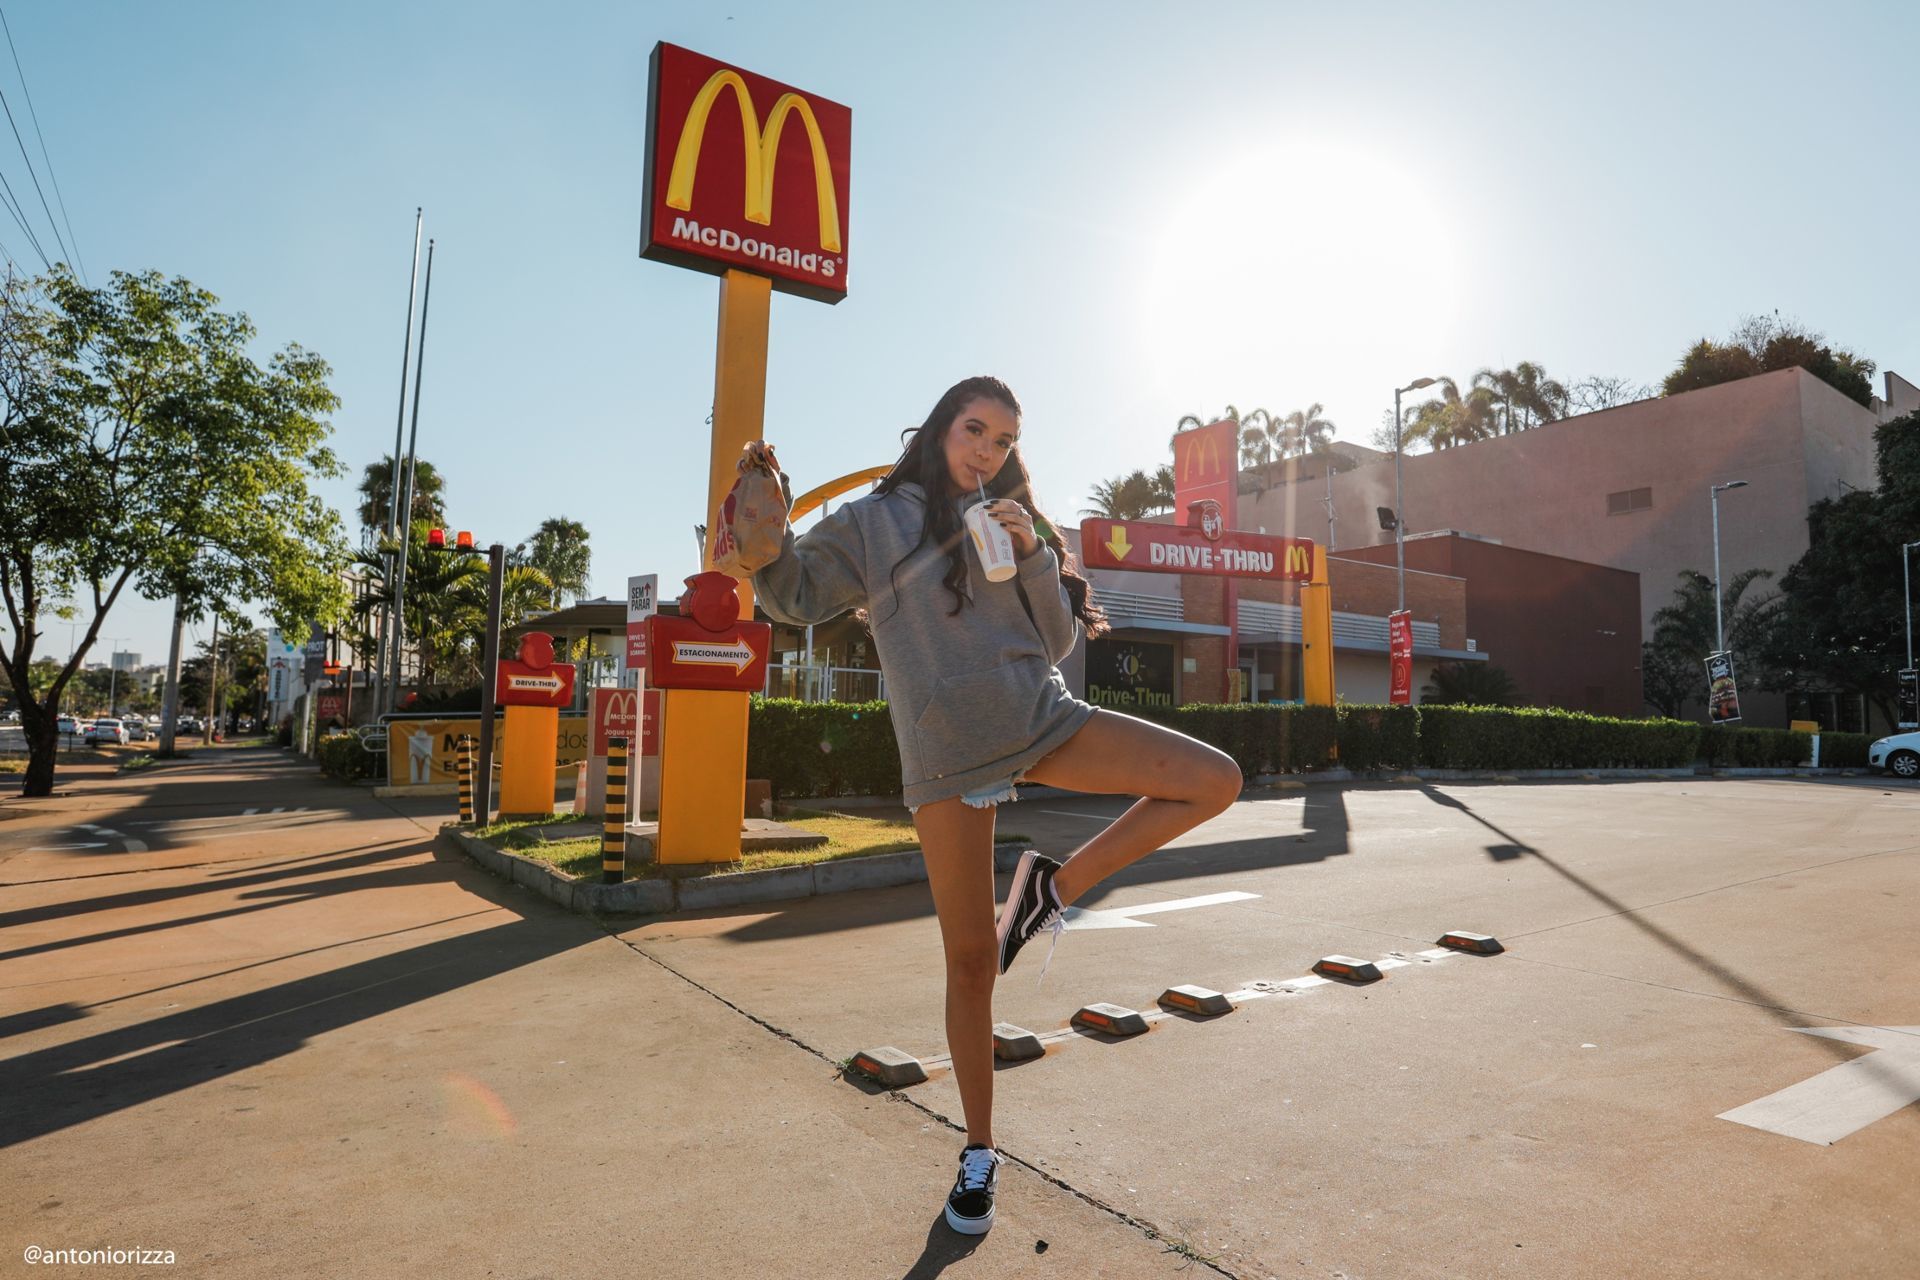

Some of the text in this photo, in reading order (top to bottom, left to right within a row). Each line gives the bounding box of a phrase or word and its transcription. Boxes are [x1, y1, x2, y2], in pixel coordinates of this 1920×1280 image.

[672, 217, 836, 277] McDonald's
[1150, 542, 1274, 572] DRIVE-THRU
[631, 587, 645, 599] SEM
[631, 599, 650, 611] PARAR
[679, 649, 750, 660] ESTACIONAMENTO
[515, 680, 557, 688] DRIVE-THRU
[1089, 685, 1171, 706] Drive-Thru
